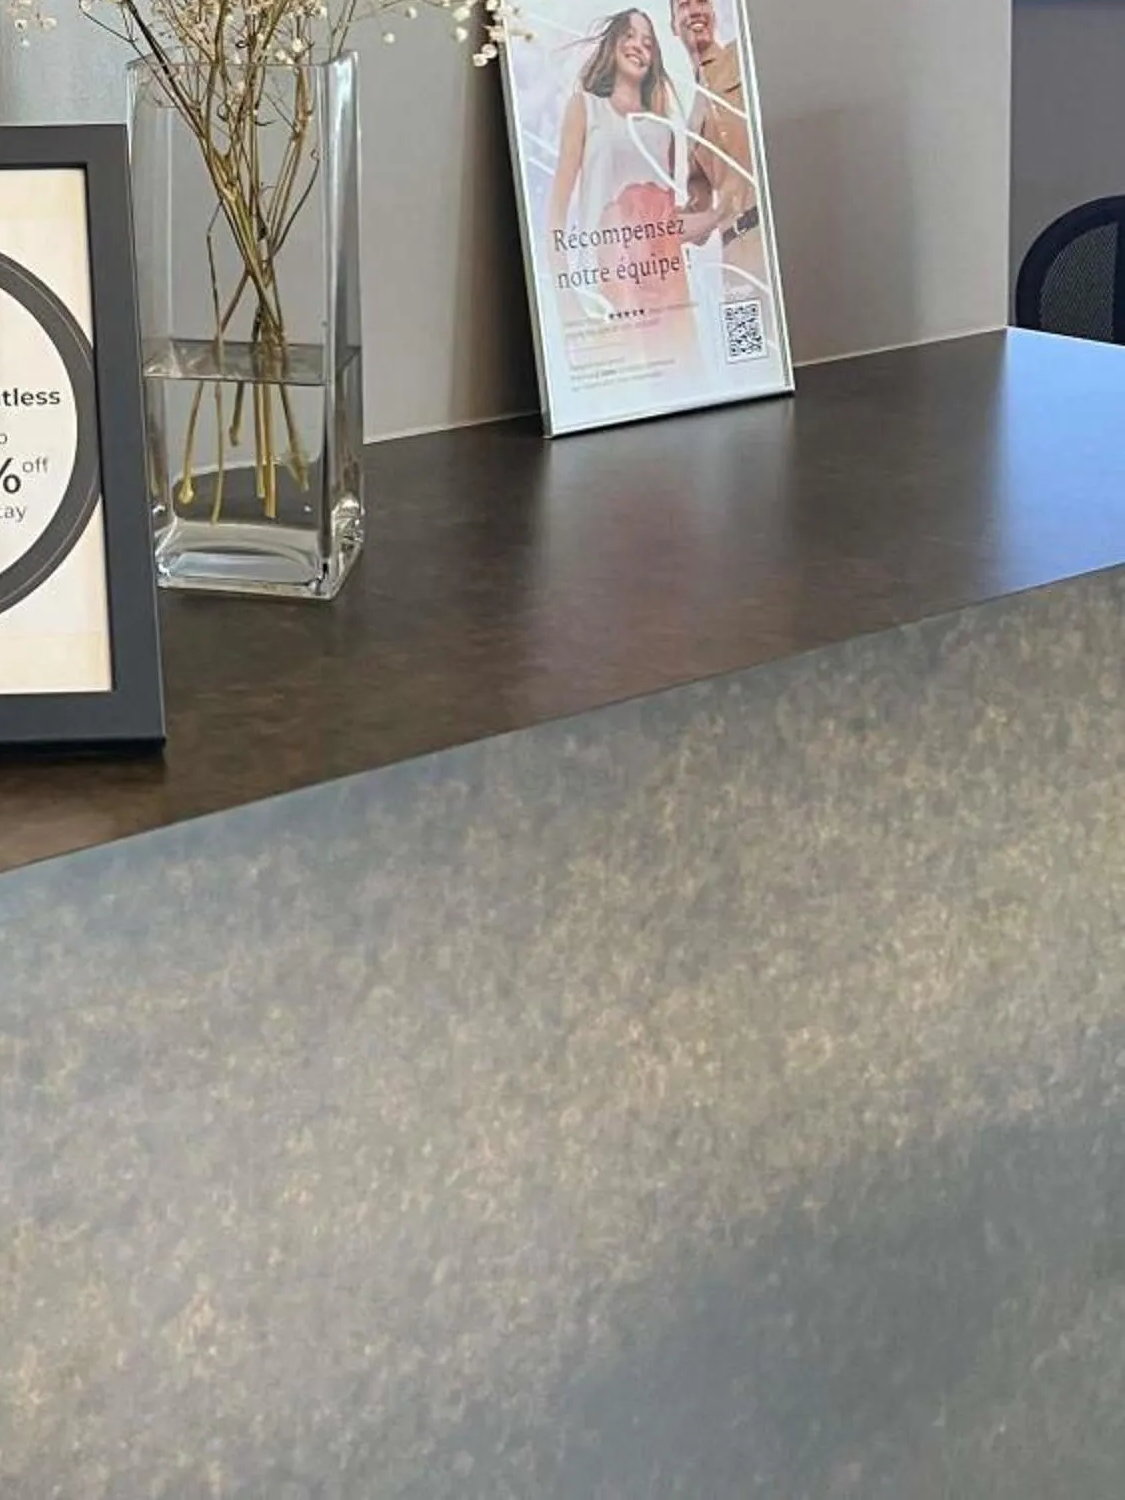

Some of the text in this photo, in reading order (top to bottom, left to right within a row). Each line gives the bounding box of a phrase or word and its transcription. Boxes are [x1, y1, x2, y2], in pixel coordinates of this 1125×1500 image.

[553, 218, 684, 251] Récompensez
[558, 267, 610, 289] notre
[616, 253, 680, 284] équipe
[22, 456, 49, 474] off
